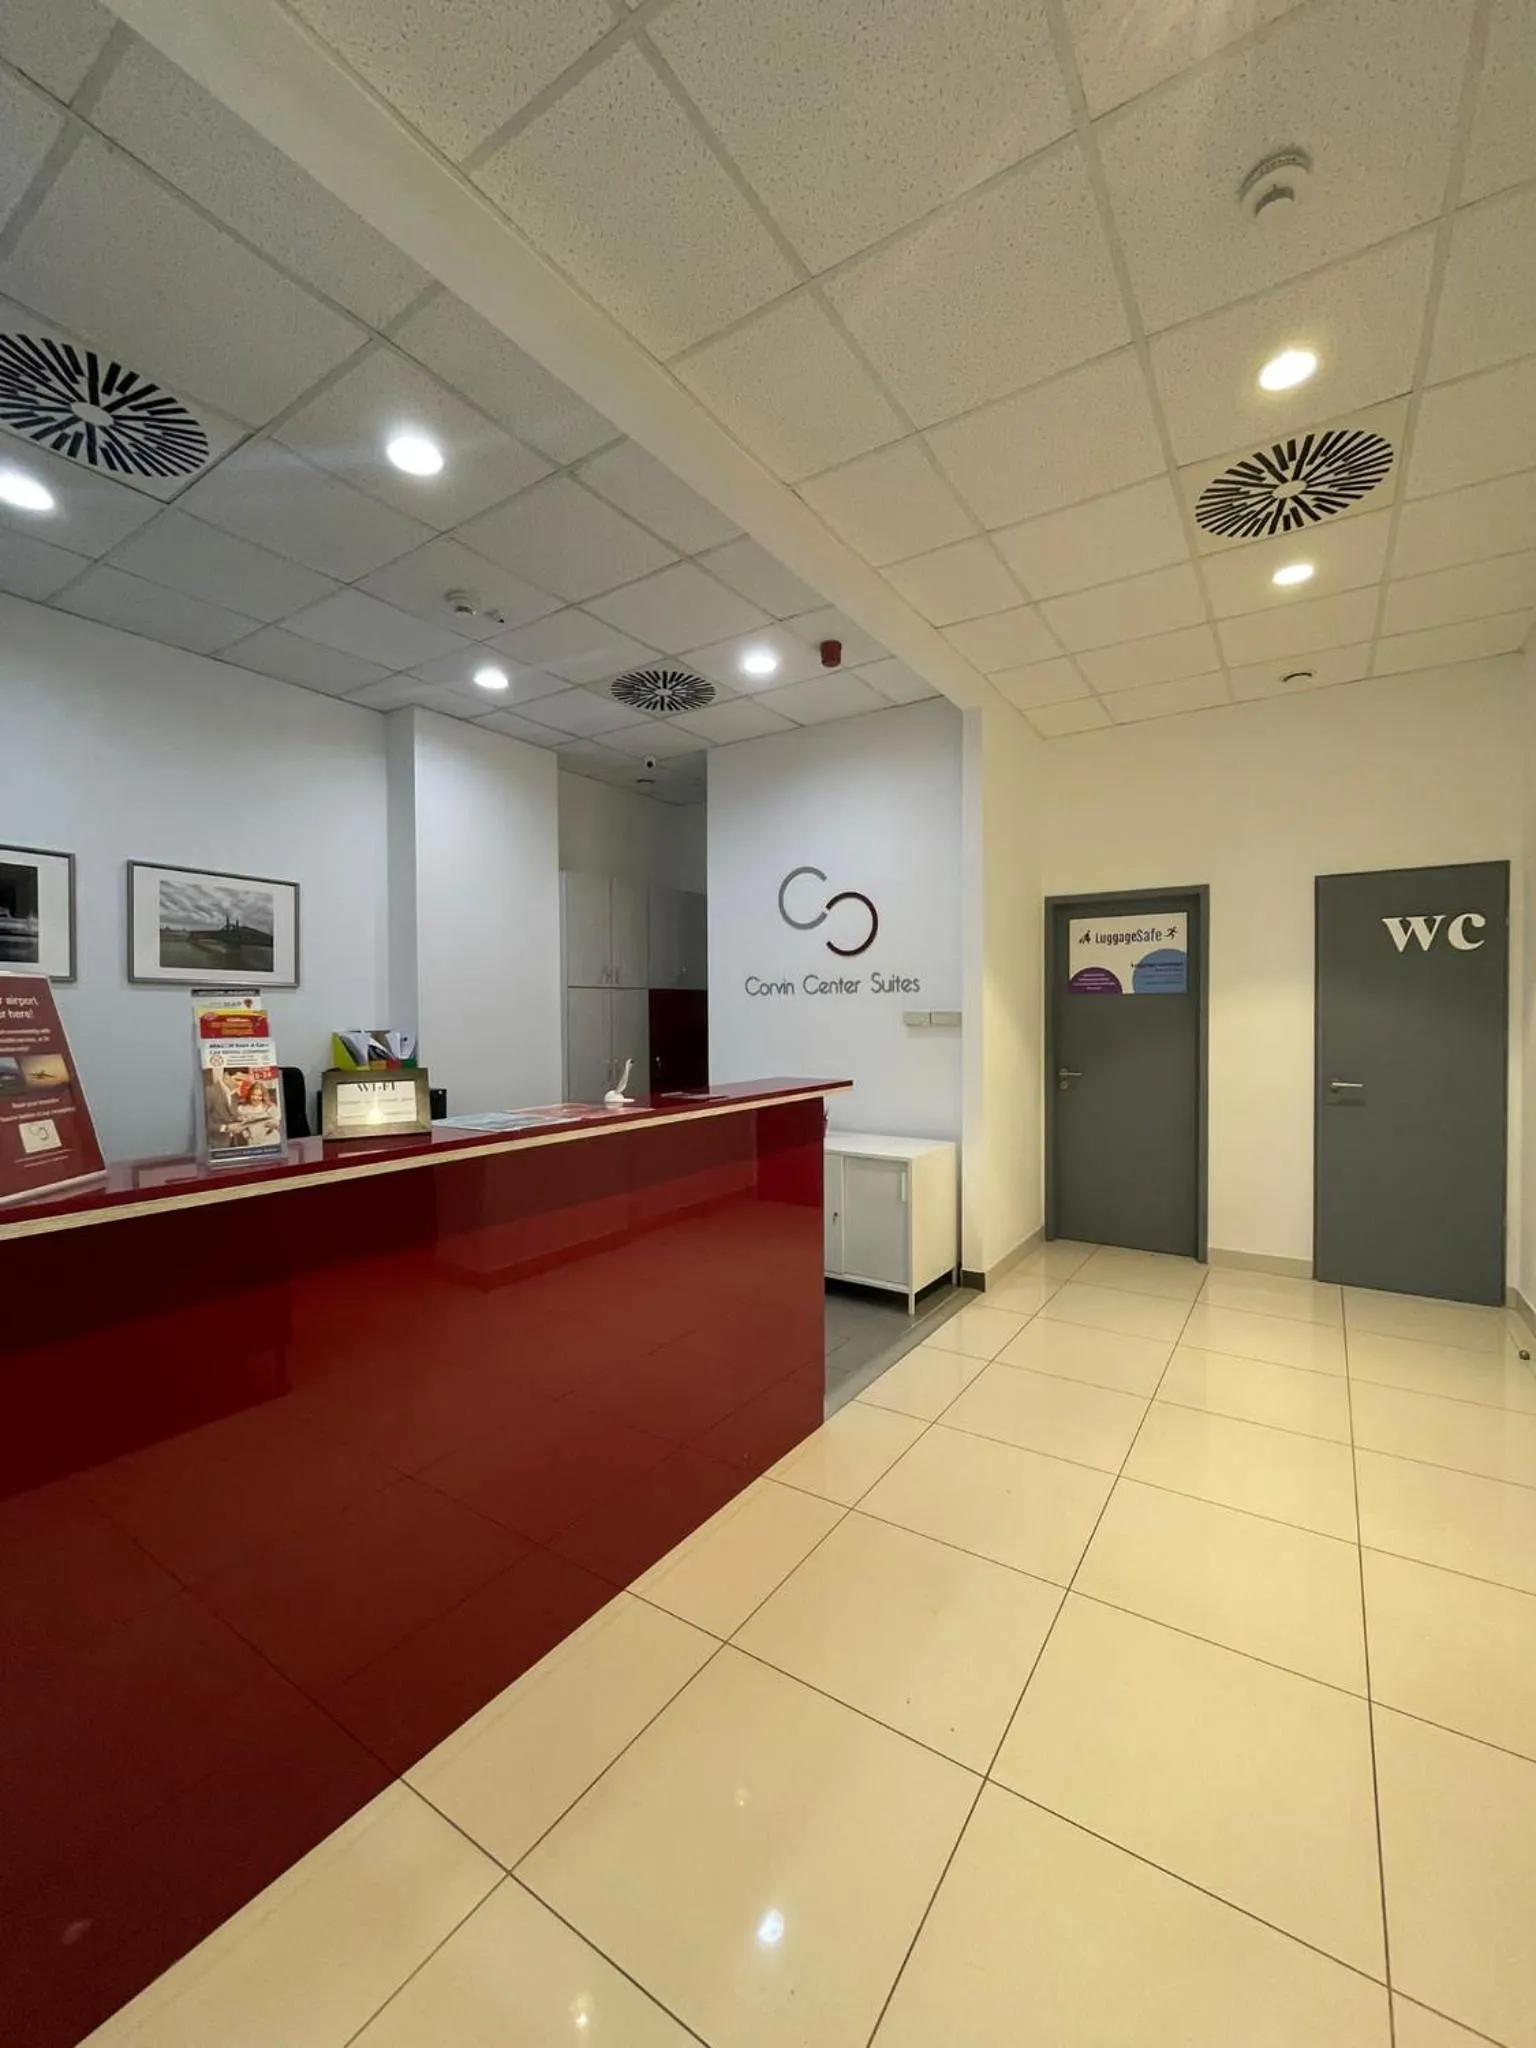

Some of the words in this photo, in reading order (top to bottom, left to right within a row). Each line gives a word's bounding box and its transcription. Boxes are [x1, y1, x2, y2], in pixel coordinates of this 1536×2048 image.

[1095, 928, 1162, 945] LuggageSafe
[745, 976, 795, 996] Corvin
[803, 974, 861, 995] Center
[870, 972, 921, 993] Suites
[6, 994, 39, 1007] airport
